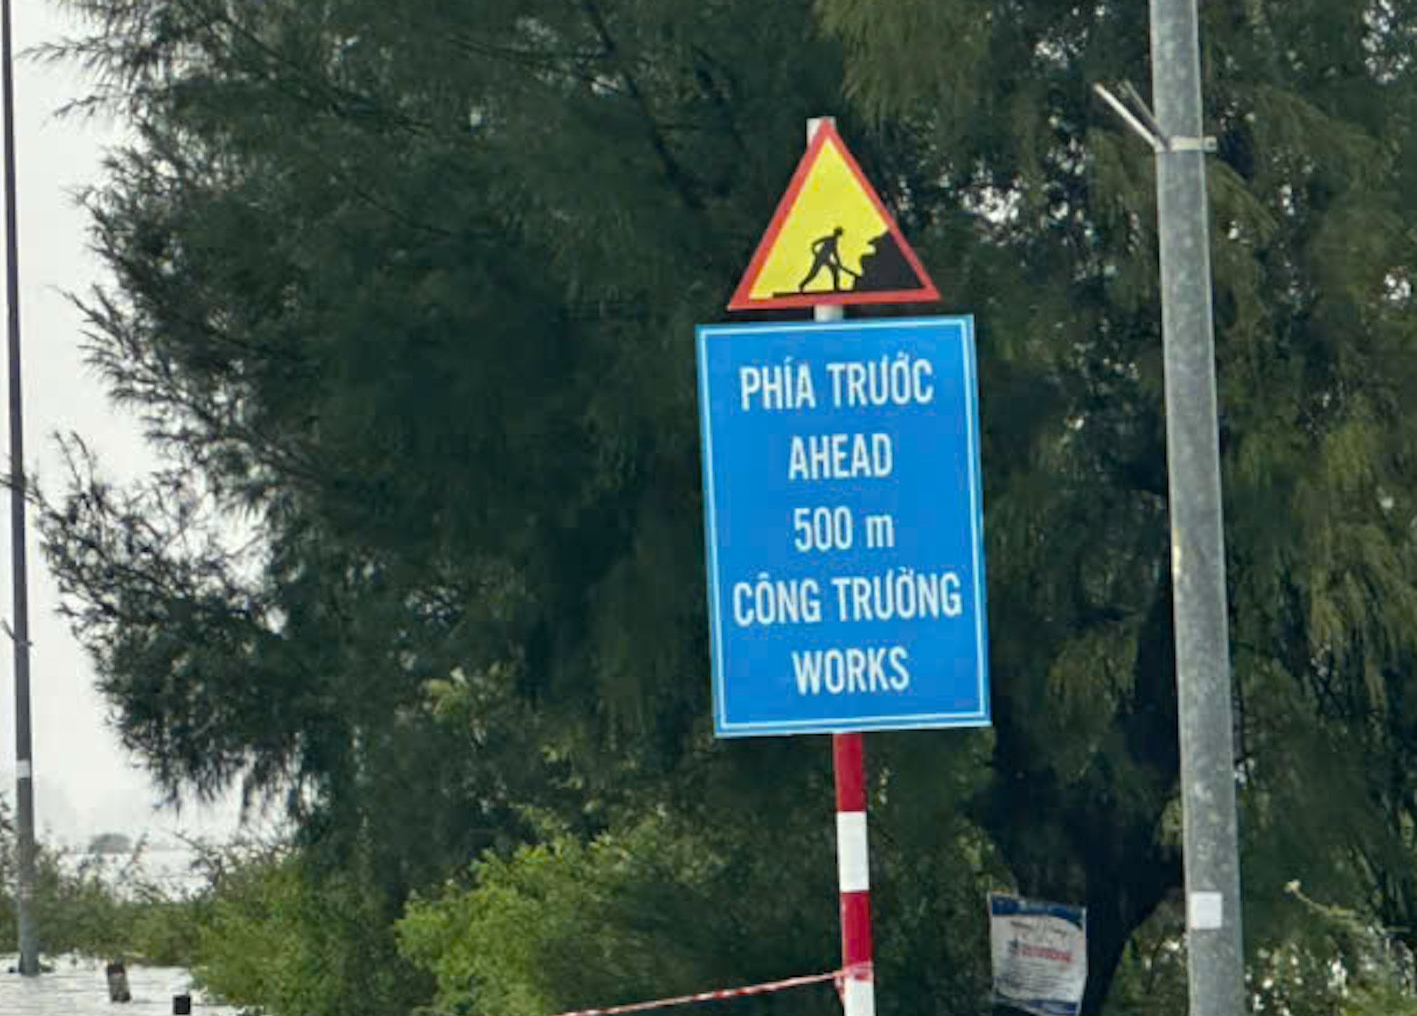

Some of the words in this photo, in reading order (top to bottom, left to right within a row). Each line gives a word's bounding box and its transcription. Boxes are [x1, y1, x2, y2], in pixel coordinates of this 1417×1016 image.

[740, 356, 816, 410] PHÍA
[826, 351, 934, 407] TRƯỚC
[789, 434, 893, 480] AHEAD
[794, 506, 854, 552] 500
[866, 514, 895, 548] m
[734, 572, 821, 626] CÔNG
[831, 566, 962, 621] TRƯỜNG
[792, 646, 910, 694] WORKS
